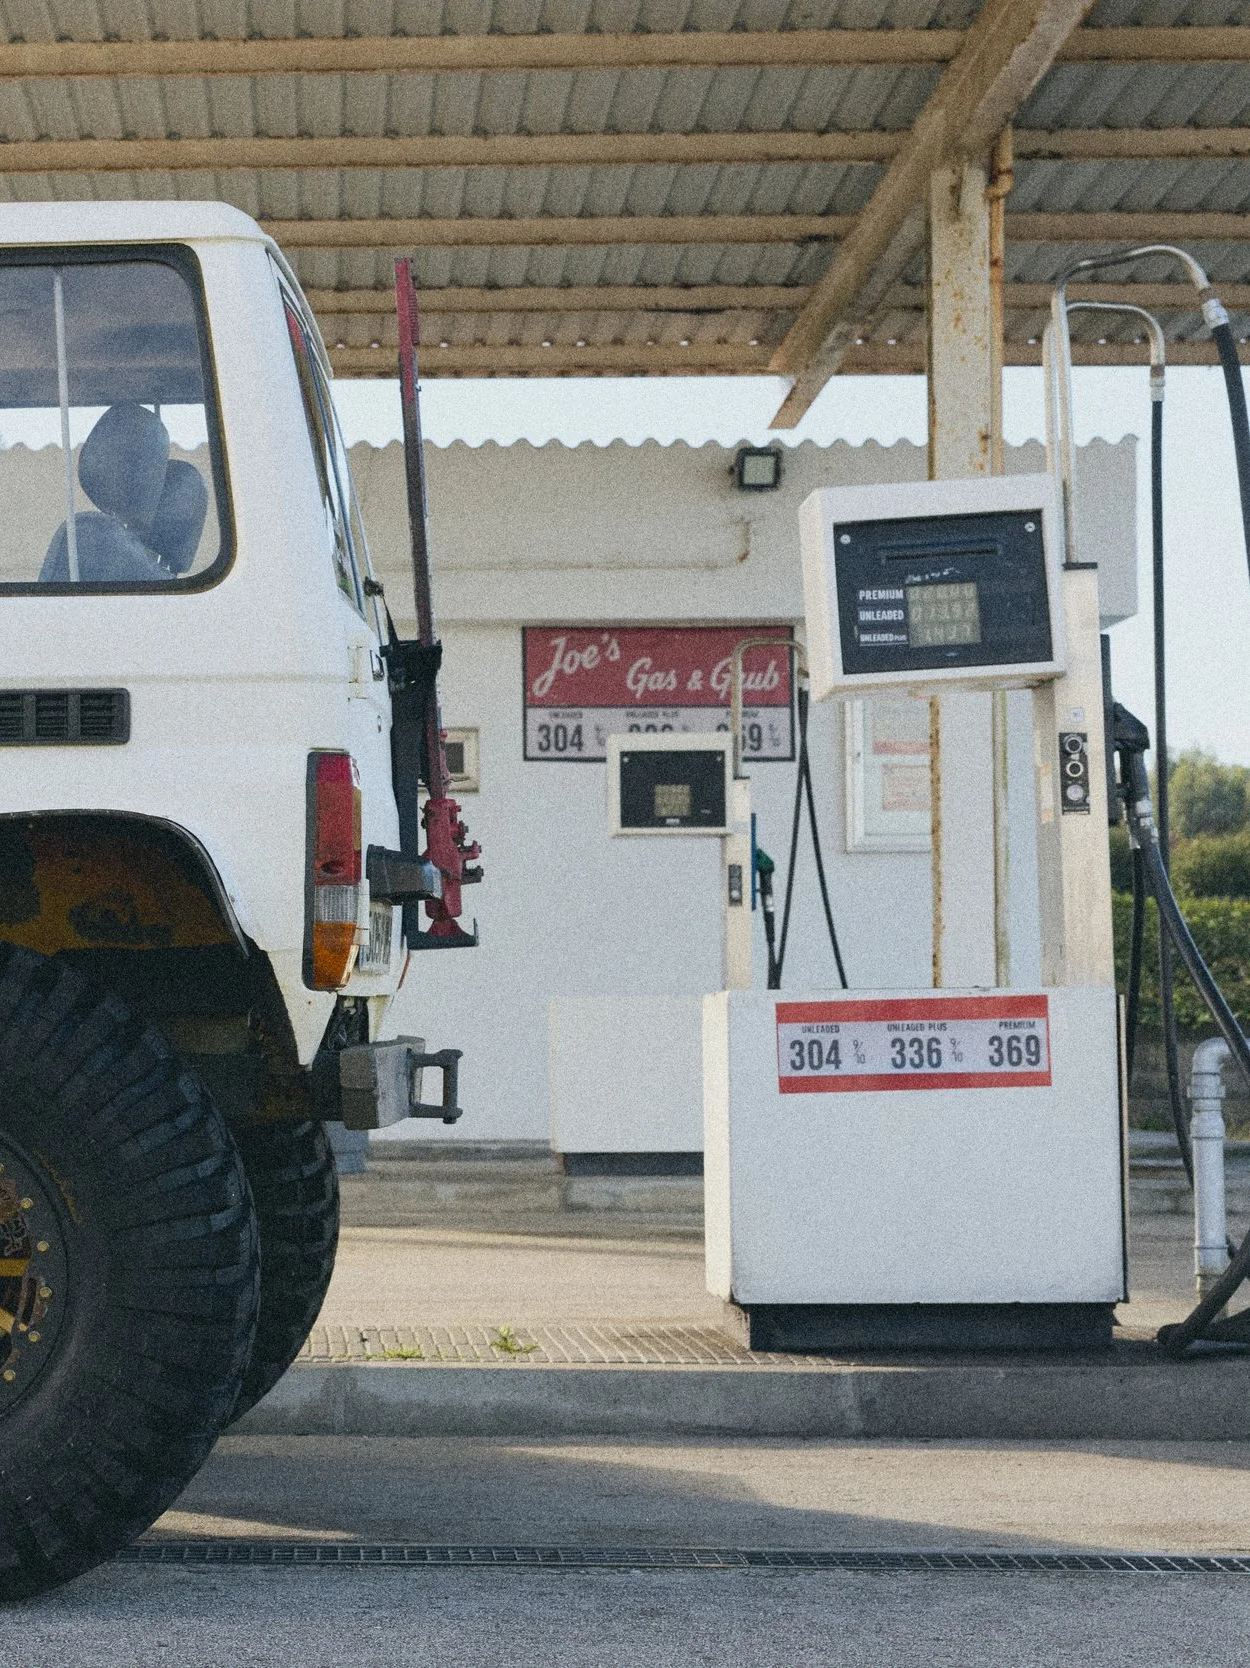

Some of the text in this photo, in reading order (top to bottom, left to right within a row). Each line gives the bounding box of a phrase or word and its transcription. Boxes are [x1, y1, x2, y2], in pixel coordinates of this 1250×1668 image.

[858, 589, 904, 600] PREMIUM
[859, 610, 904, 621] UNLEADED
[532, 633, 621, 697] Joe's
[626, 656, 780, 699] Gas & Gub
[538, 724, 584, 752] 304
[801, 1024, 840, 1034] UNLEADED
[887, 1022, 948, 1032] UNLEADED PLUS
[999, 1020, 1036, 1030] PREMIUM
[790, 1039, 842, 1071] 304
[891, 1037, 942, 1069] 336
[988, 1034, 1041, 1067] 369
